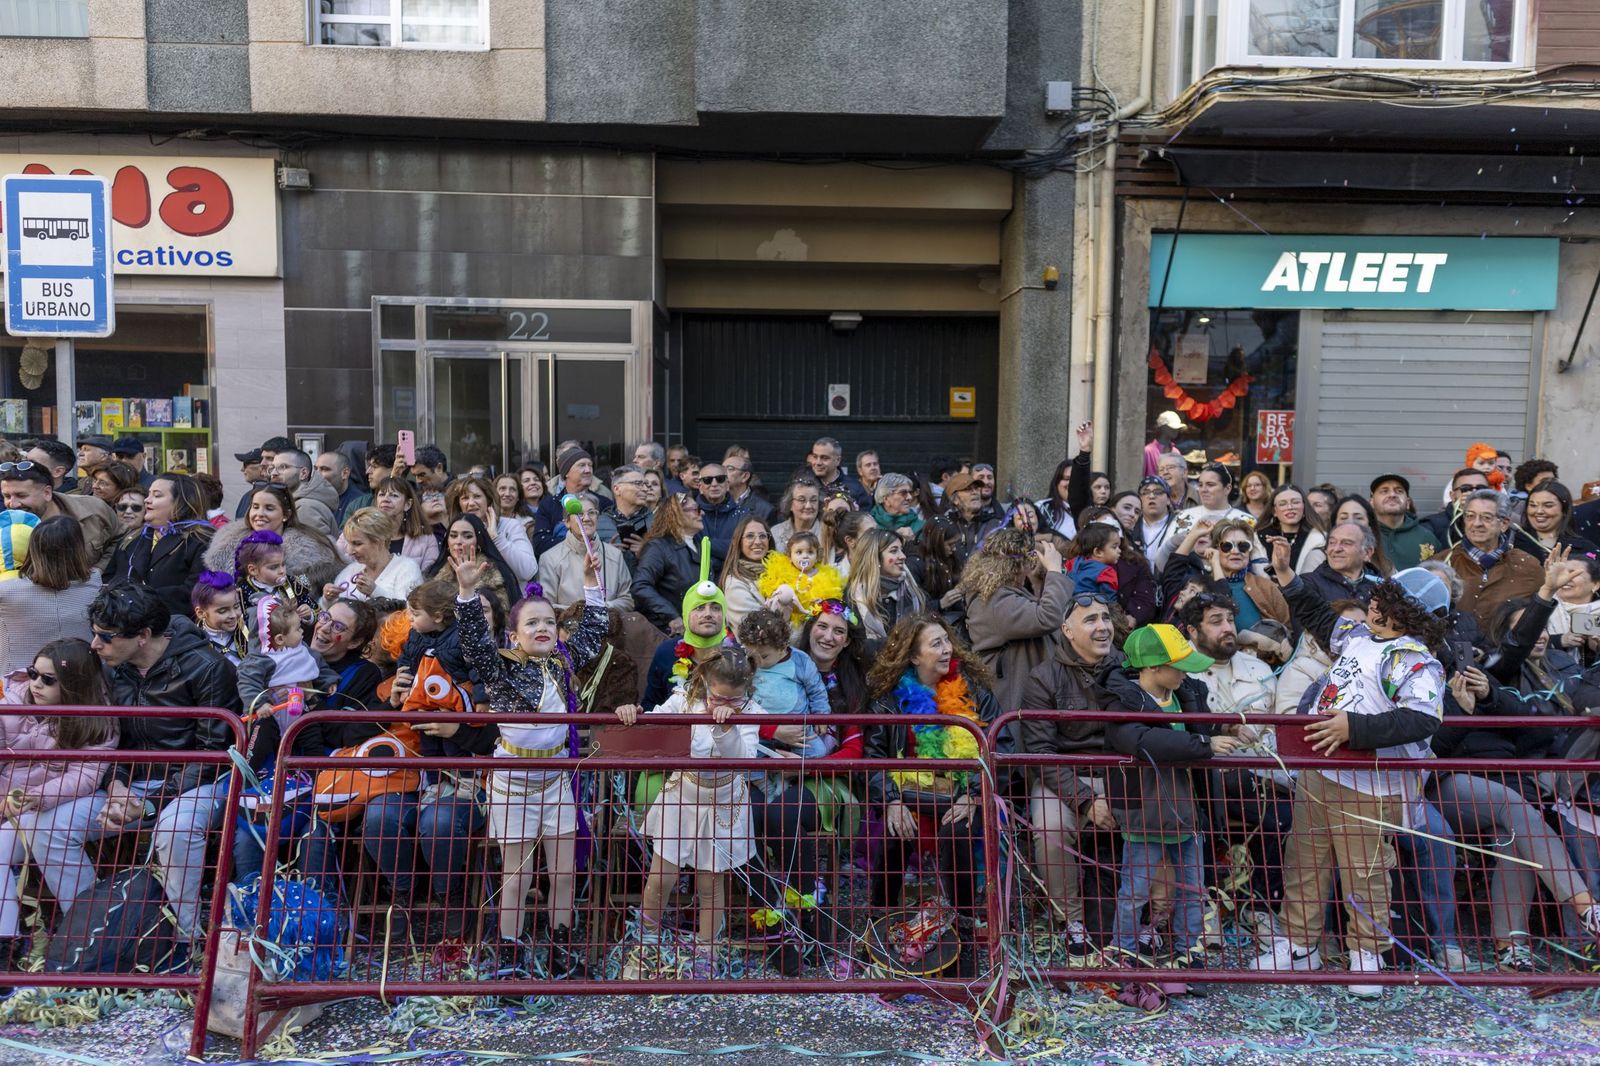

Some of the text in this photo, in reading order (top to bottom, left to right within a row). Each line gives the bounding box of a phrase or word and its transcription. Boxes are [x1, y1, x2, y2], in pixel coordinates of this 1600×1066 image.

[112, 245, 234, 267] cativos
[1261, 251, 1448, 294] ATLEET
[42, 282, 74, 297] BUS
[25, 301, 91, 317] URBANO
[507, 311, 550, 341] 22
[1267, 413, 1287, 426] RE
[1266, 425, 1287, 437] BA
[1261, 437, 1290, 449] JAS
